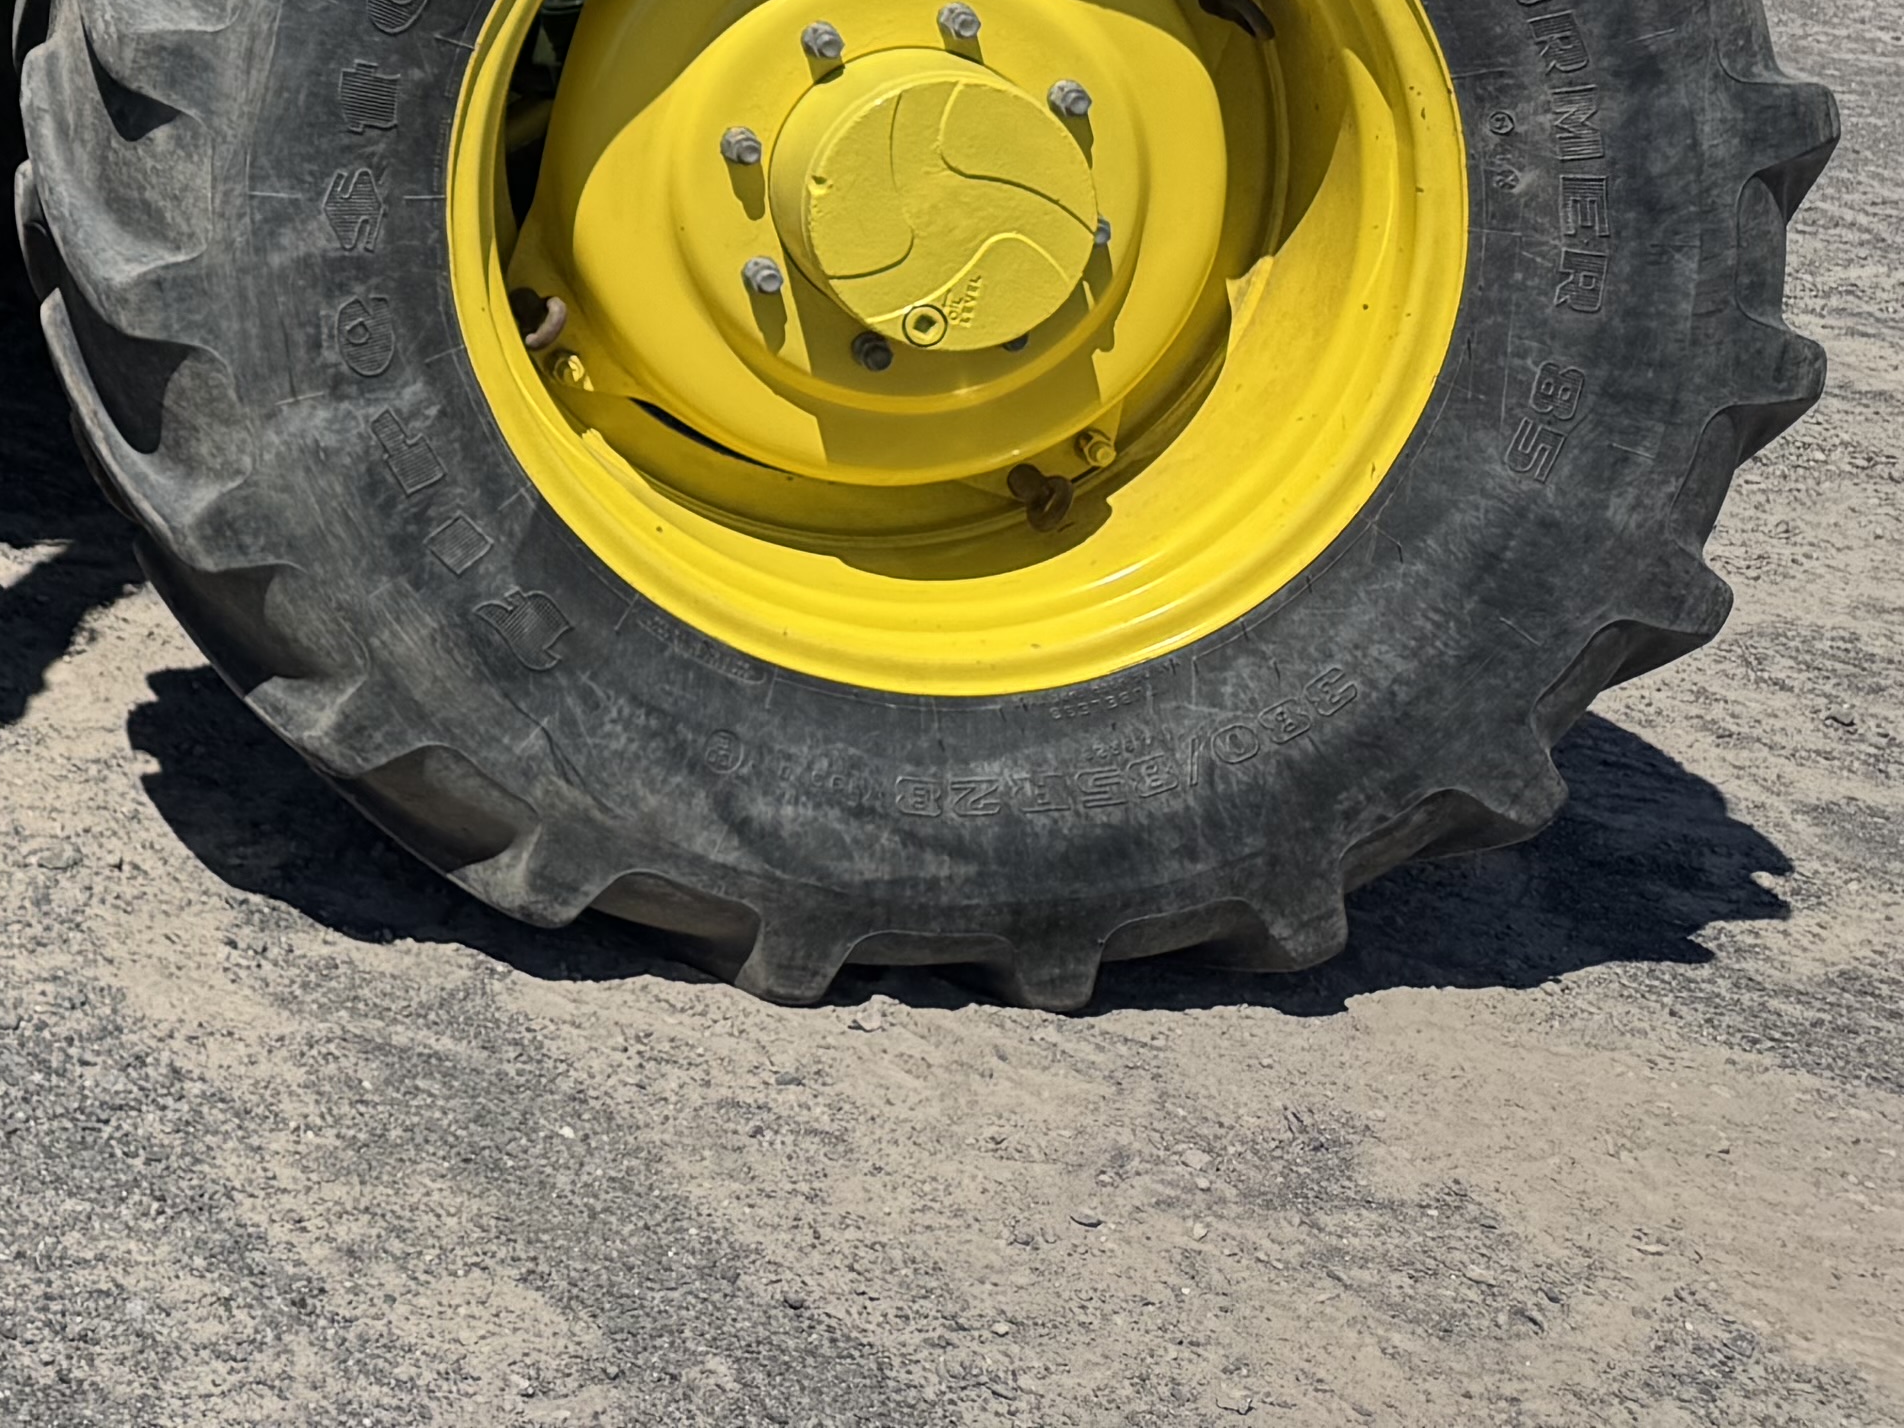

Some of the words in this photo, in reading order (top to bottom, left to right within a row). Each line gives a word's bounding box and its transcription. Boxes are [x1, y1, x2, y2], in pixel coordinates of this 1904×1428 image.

[949, 297, 963, 320] OIL
[960, 275, 982, 324] LEVEL
[1505, 361, 1587, 484] 85
